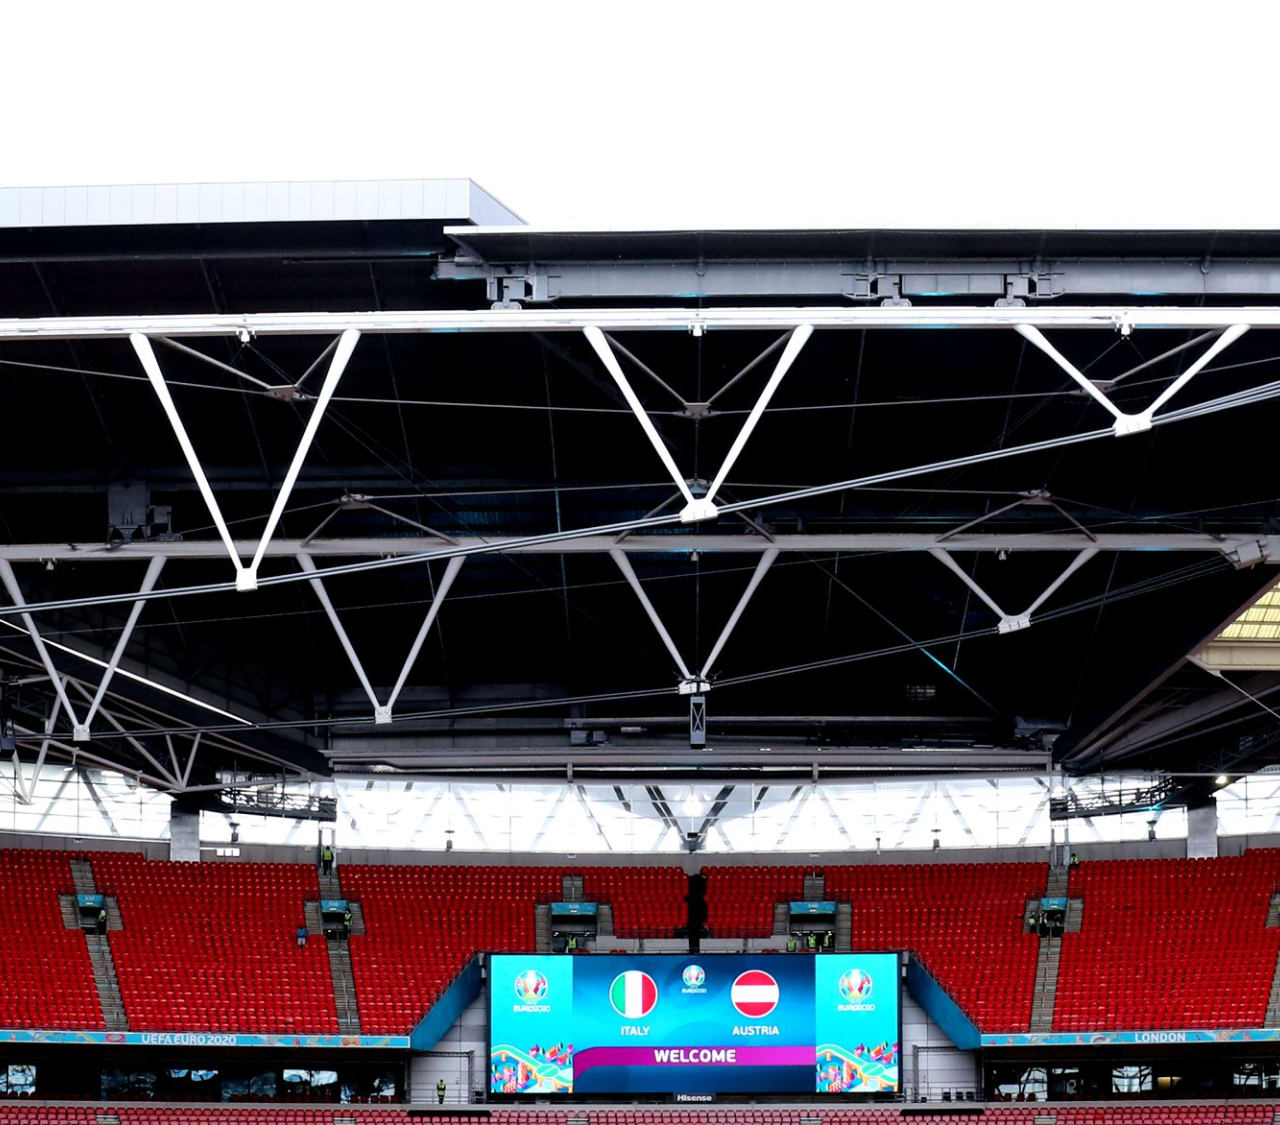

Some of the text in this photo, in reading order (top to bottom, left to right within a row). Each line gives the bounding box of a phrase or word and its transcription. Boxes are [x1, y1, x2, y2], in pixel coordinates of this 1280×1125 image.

[620, 1025, 650, 1036] ITALY
[732, 1025, 780, 1036] AUSTRIA
[141, 1033, 237, 1045] UEFA EURO 2020
[1134, 1032, 1186, 1043] LONDON
[654, 1049, 736, 1063] WELCOME
[676, 1093, 712, 1102] Hisense
